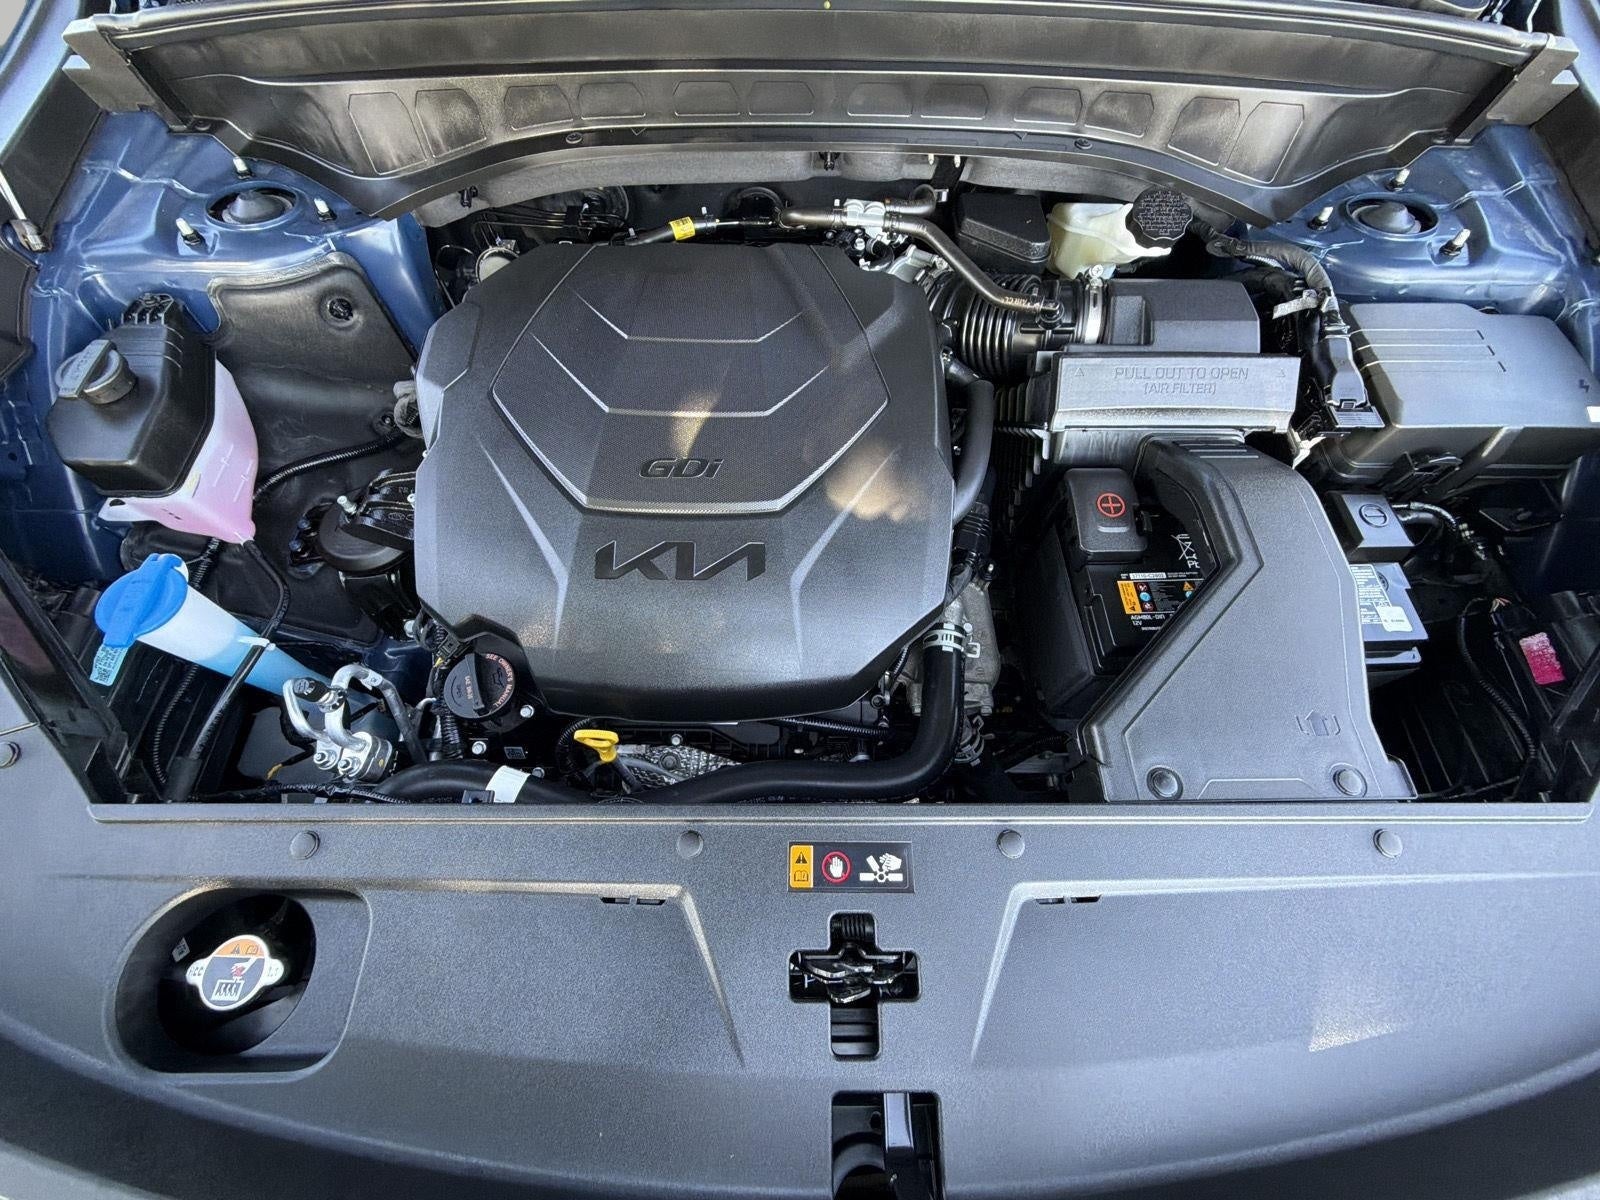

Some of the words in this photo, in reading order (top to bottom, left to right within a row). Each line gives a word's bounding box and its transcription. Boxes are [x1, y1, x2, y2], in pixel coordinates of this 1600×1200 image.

[1114, 366, 1150, 380] PULL
[1155, 366, 1186, 380] OUT
[1189, 366, 1206, 380] TO
[1210, 366, 1249, 380] OPEN
[1143, 382, 1172, 395] (AIR
[1173, 382, 1217, 395] FILTER)
[639, 457, 725, 478] GDi
[594, 540, 766, 581] KIA
[485, 653, 499, 661] SEE
[493, 684, 513, 707] MANUAL
